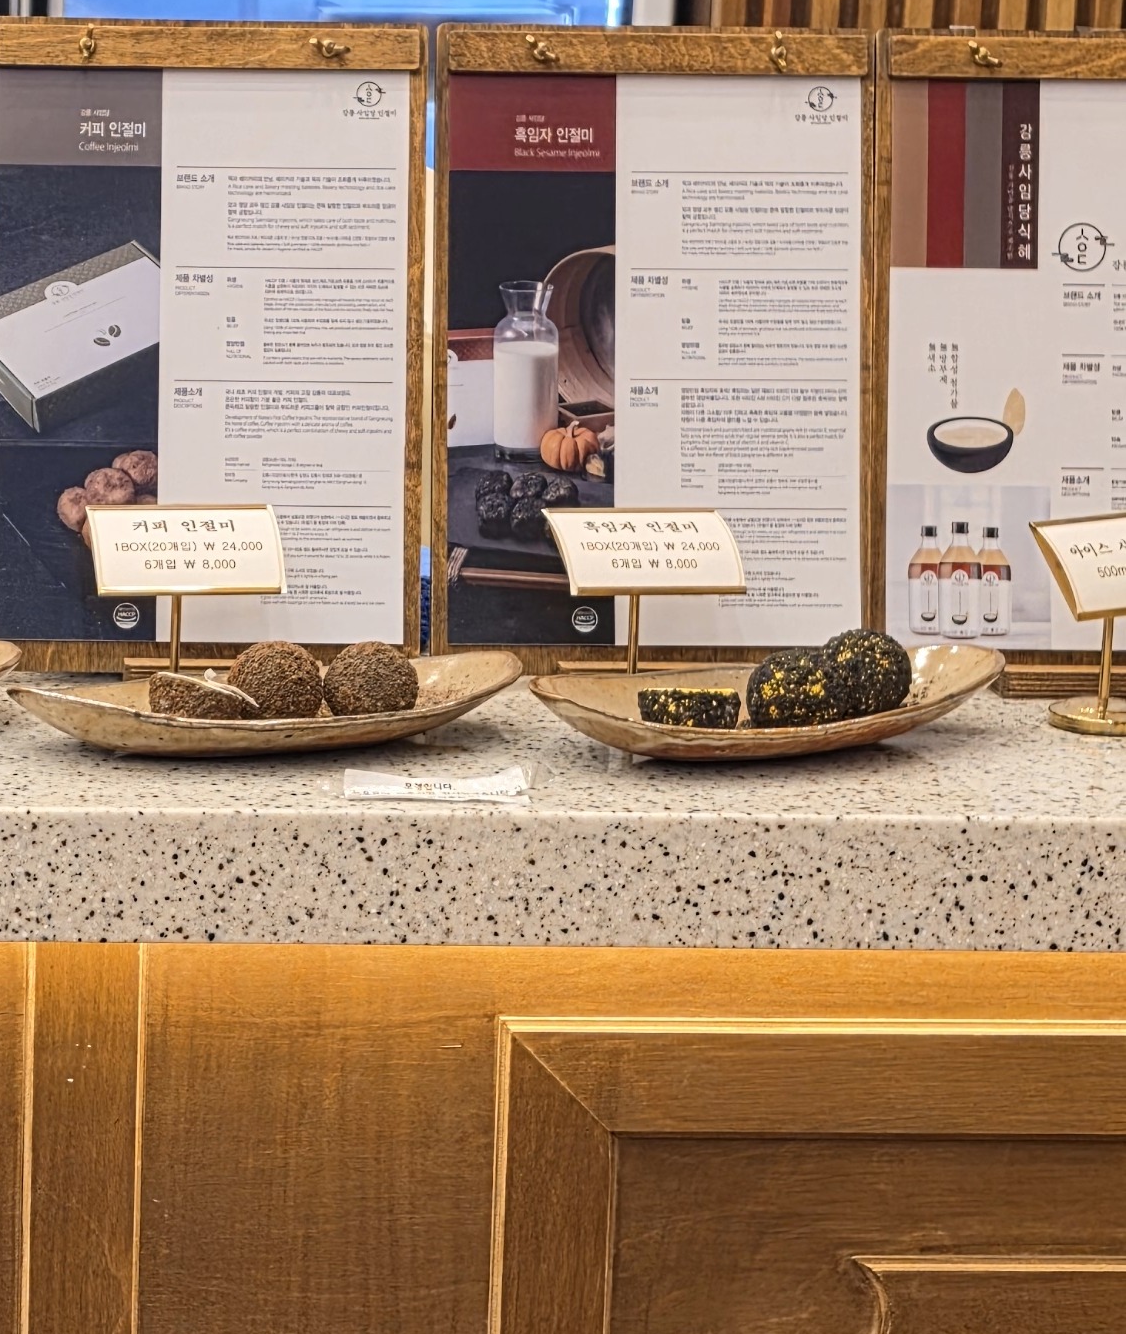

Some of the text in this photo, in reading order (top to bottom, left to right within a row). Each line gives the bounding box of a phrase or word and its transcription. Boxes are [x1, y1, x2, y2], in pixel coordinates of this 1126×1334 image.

[80, 121, 145, 137] 커피 인절미
[514, 127, 593, 143] 흑임자 인절미
[79, 142, 138, 153] Coffee Injeolmi
[514, 148, 534, 156] Black
[537, 148, 566, 157] Sesame
[177, 174, 215, 183] 브랜드 소개
[655, 179, 669, 188] 소개
[175, 274, 214, 283] 제품 차별성
[174, 388, 203, 396] 제품소개
[132, 520, 235, 533] 커피 인절미
[583, 521, 699, 533] 흑임자 인절미
[115, 542, 197, 552] 1BOX(20개입)
[222, 542, 263, 552] 24,000
[580, 542, 658, 552] 1BOX(20개입)
[681, 542, 720, 551] 24,000
[1070, 542, 1113, 559] 아이스
[145, 560, 176, 570] 6개입
[202, 560, 236, 570] 8,000
[612, 559, 642, 569] 6개입
[666, 559, 698, 569] 8,000
